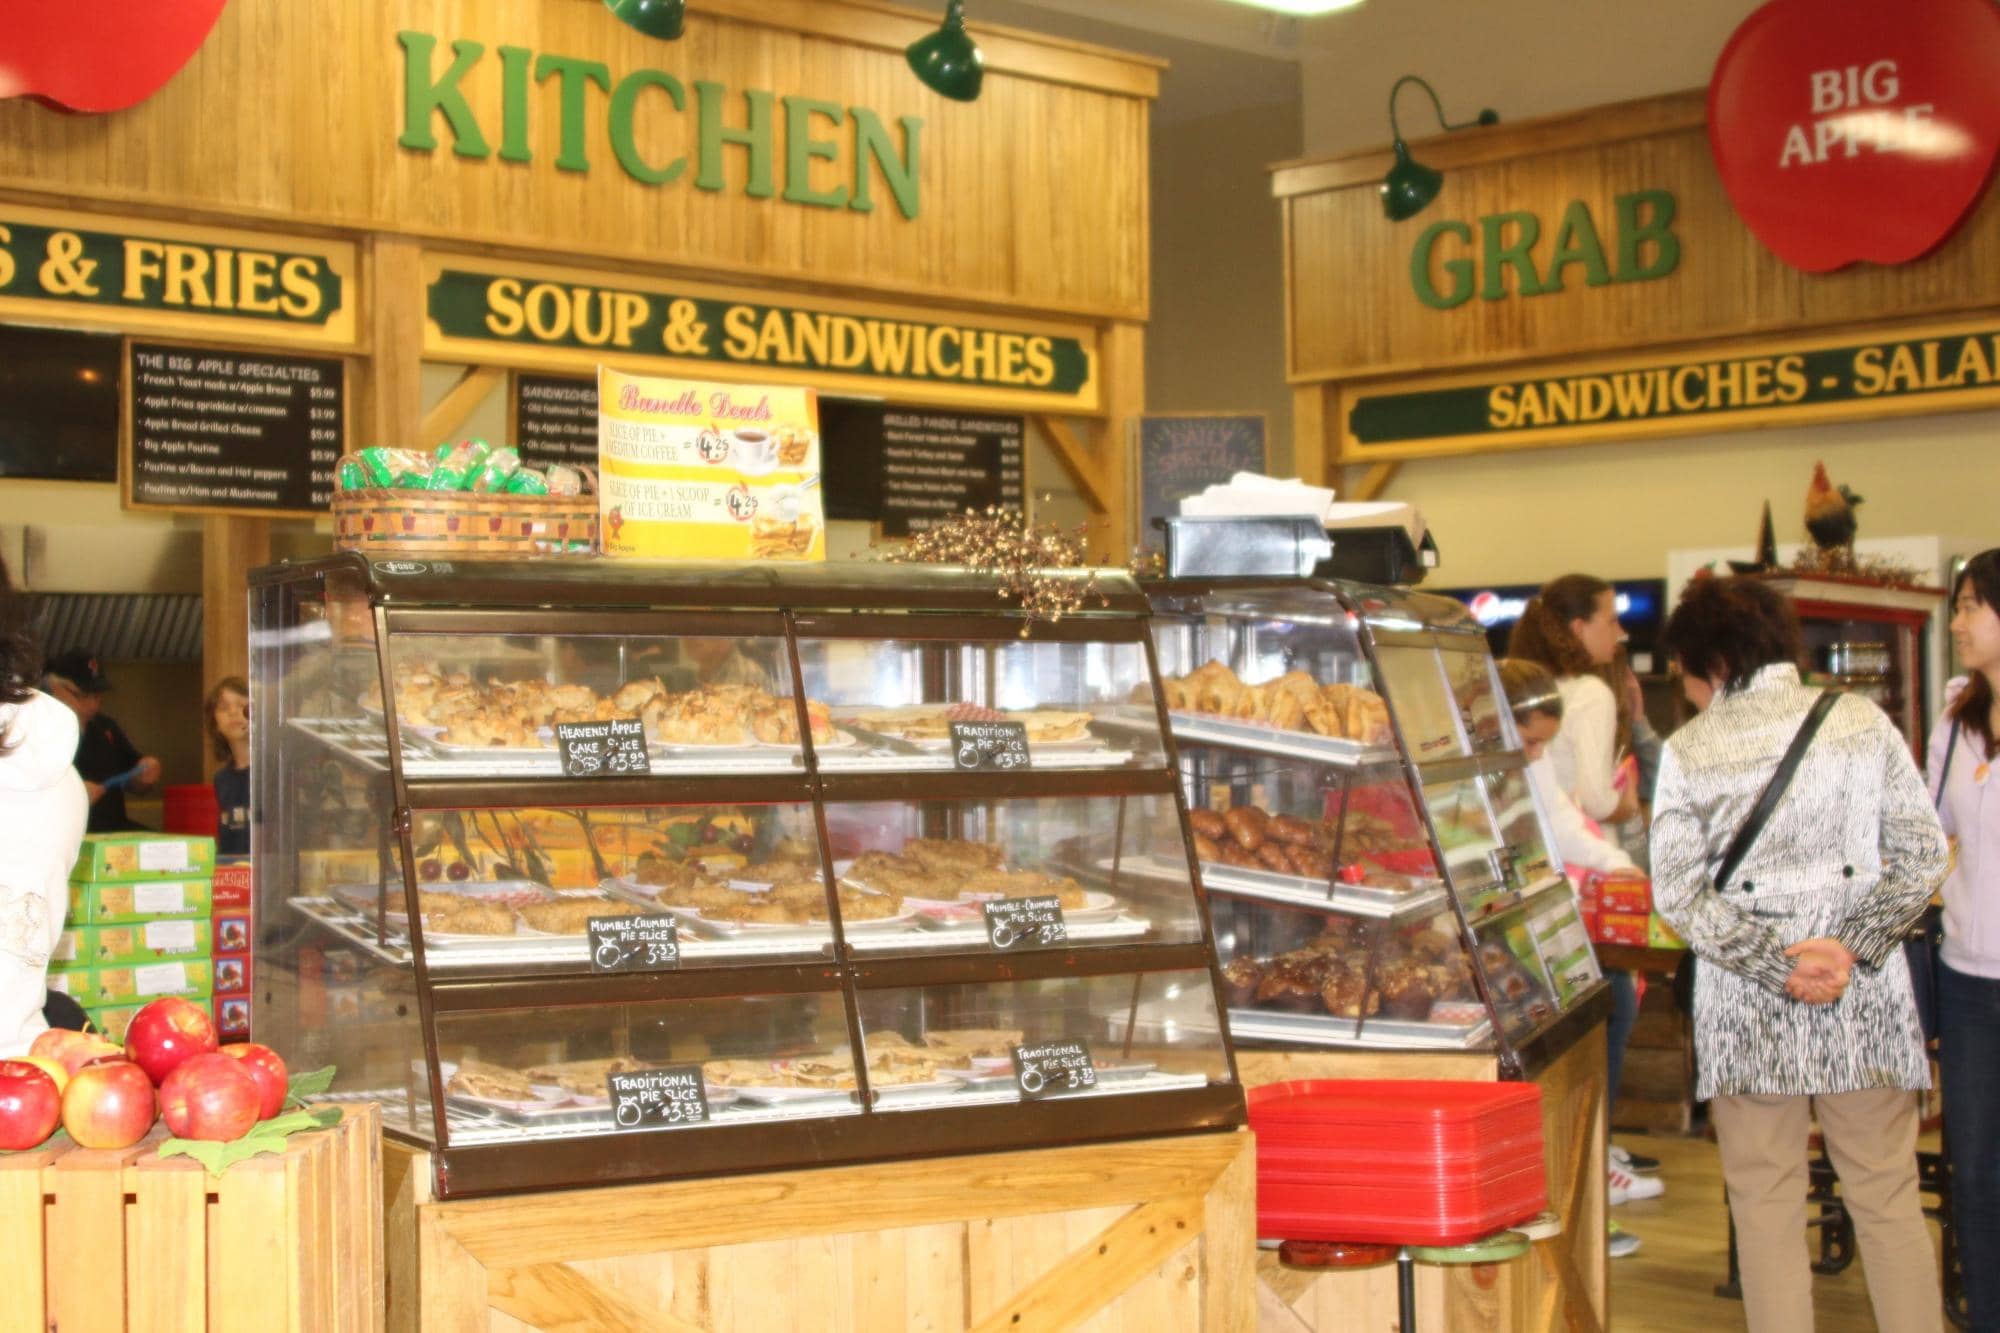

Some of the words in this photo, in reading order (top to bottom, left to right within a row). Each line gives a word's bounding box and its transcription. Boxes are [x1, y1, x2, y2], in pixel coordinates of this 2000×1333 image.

[1810, 59, 1899, 114] BIG
[397, 30, 924, 220] KITCHEN
[1410, 189, 1681, 309] GRAB
[39, 231, 99, 296] &
[123, 240, 321, 317] FRIES
[486, 278, 649, 346] SOUP
[663, 299, 709, 355] &
[722, 305, 1054, 386] SANDWICHES
[137, 353, 164, 369] THE
[168, 357, 192, 371] BIG
[198, 359, 233, 375] APPLE
[238, 364, 319, 382] SPECIALTIES
[144, 374, 175, 386] French
[178, 377, 201, 388] Toast
[1487, 356, 1806, 428] SANDWICHES
[1854, 335, 2000, 394] SALA
[144, 397, 169, 409] Apple
[171, 398, 194, 409] Fries
[619, 383, 703, 417] Bundle
[709, 392, 773, 420] Deals
[144, 418, 169, 431] Apple
[171, 420, 198, 431] Bread
[199, 422, 229, 434] Grilled
[231, 424, 262, 436] Cheese
[628, 424, 641, 441] OF
[643, 426, 657, 442] PIE
[144, 440, 158, 452] Big
[161, 441, 185, 453] Apple
[187, 442, 220, 454] Poutine
[606, 440, 639, 459] MEDIUM
[640, 442, 679, 461] COFFEE
[144, 462, 177, 474] Poutine
[218, 466, 233, 477] and
[235, 466, 251, 478] Hot
[144, 484, 177, 495] Poutine
[212, 486, 227, 497] and
[312, 492, 331, 503] $6.9
[629, 482, 641, 497] OF
[643, 483, 658, 498] PIE
[676, 486, 710, 502] SCOOP
[624, 500, 636, 516] OF
[638, 501, 655, 517] ICE
[656, 502, 692, 519] CREAM
[559, 725, 608, 739] HEAVENLY
[611, 720, 642, 735] APPLE
[955, 723, 1023, 737] TRADITION
[568, 741, 599, 754] CAKE
[977, 738, 993, 750] PIE
[996, 738, 1023, 751] ICE
[1011, 913, 1025, 923] PIE
[1027, 910, 1055, 921] SLICE
[621, 930, 635, 942] PIE
[639, 929, 667, 940] SLICE
[646, 943, 676, 964] 3.33
[1017, 1044, 1082, 1060] TRADITIONAL
[1043, 1057, 1058, 1070] PIE
[1061, 1055, 1087, 1068] SLICE
[612, 1072, 697, 1090] TRADITIONAL
[640, 1088, 660, 1104] PIE
[664, 1086, 698, 1100] SLICE
